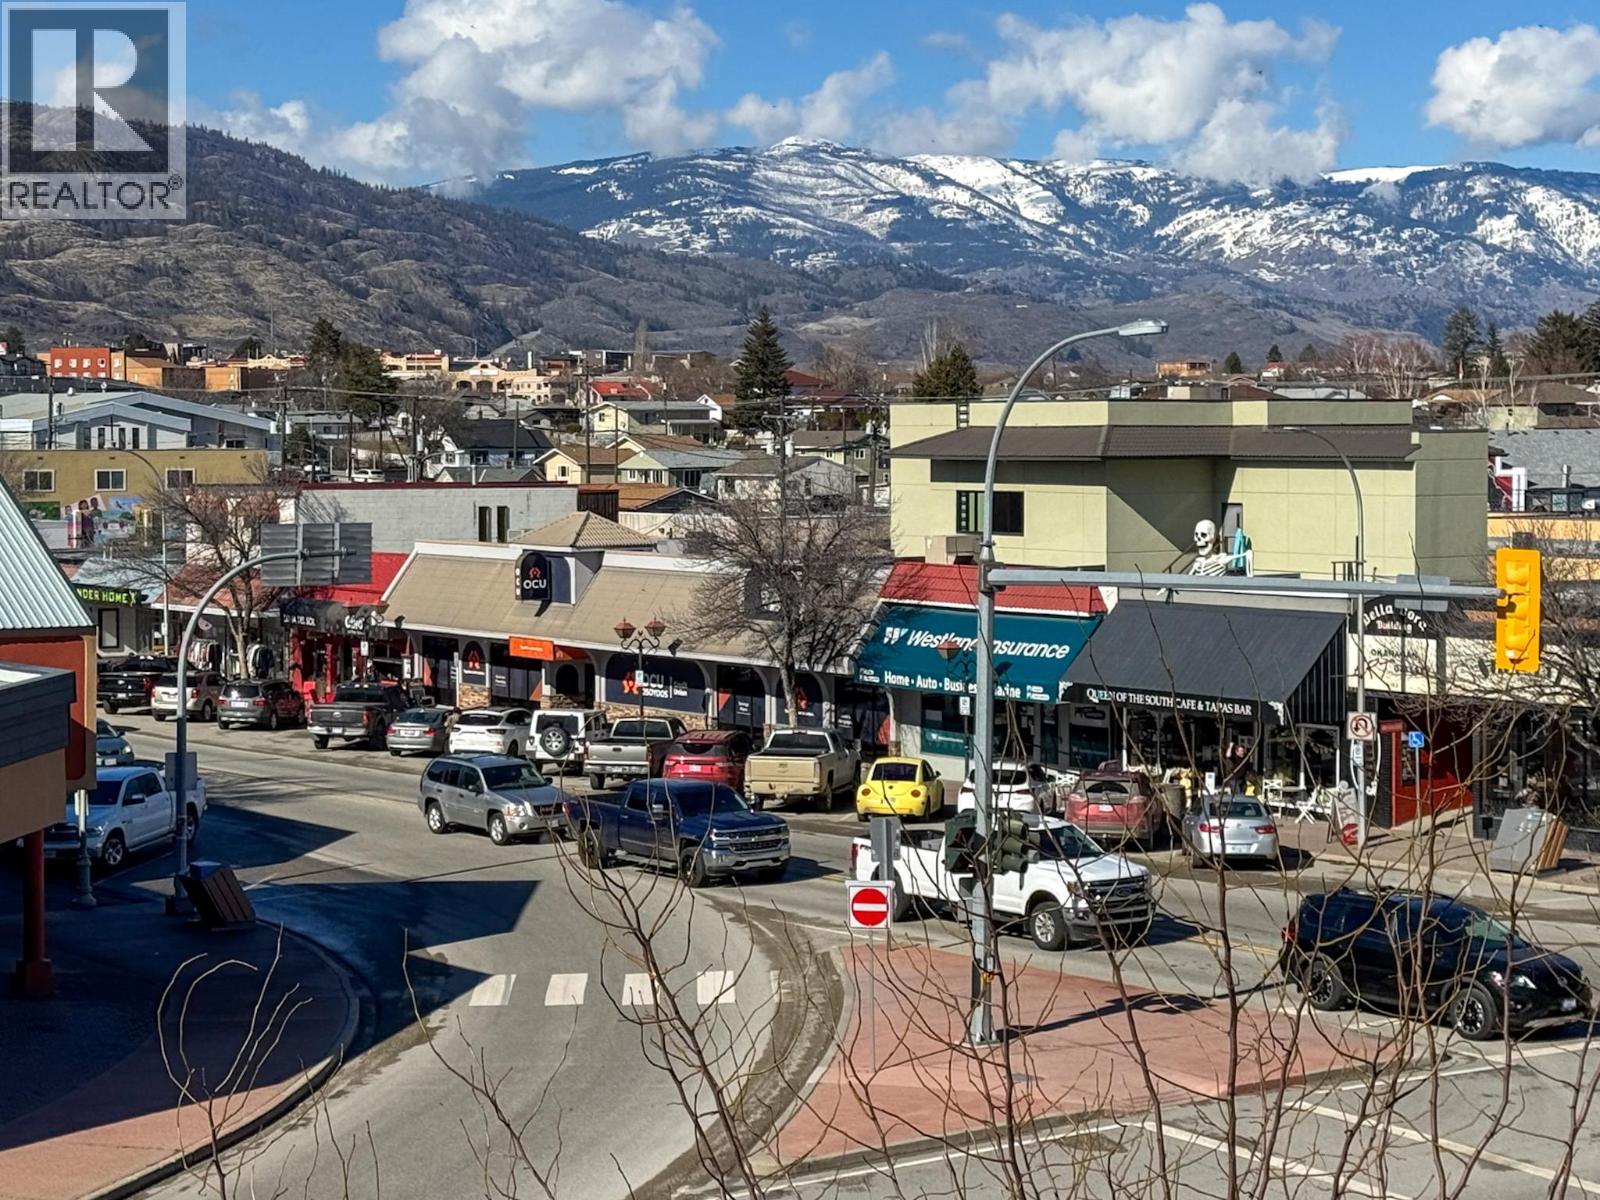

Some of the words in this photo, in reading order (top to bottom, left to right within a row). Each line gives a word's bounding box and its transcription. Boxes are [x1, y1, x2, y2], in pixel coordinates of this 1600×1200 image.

[522, 578, 547, 589] OCU
[101, 591, 129, 604] HOME
[993, 639, 1071, 659] nsurance
[673, 688, 688, 697] Union
[884, 670, 910, 686] Home
[916, 674, 937, 689] Auto
[944, 677, 978, 694] Busies
[994, 683, 1021, 699] arine
[1086, 688, 1116, 703] QUEEN
[1116, 692, 1127, 702] OF
[1128, 692, 1145, 704] THE
[1145, 695, 1174, 708] SOUTH
[1197, 701, 1204, 711] &
[1234, 703, 1252, 716] BAR
